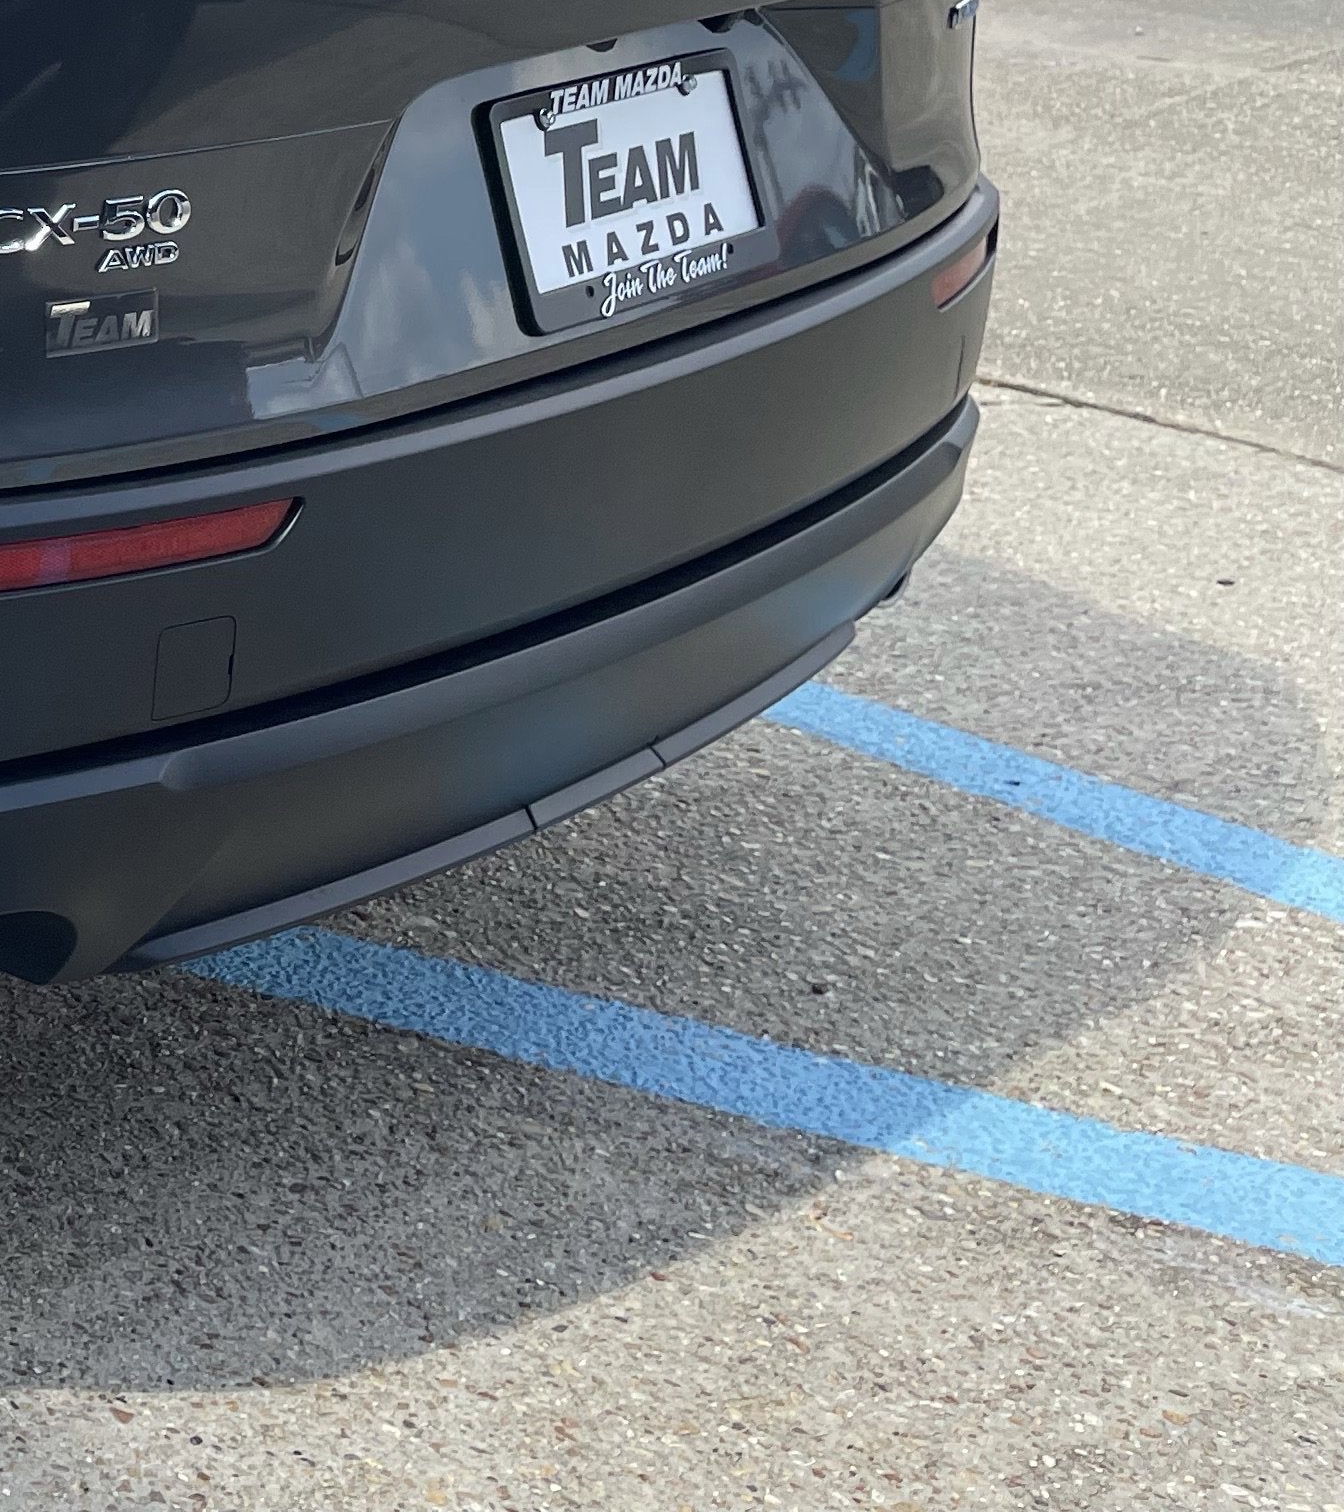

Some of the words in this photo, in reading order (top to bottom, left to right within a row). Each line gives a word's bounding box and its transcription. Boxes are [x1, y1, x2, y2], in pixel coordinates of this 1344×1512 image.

[550, 82, 610, 116] TEAM
[614, 61, 682, 101] MAZDA
[543, 118, 700, 228] TEAM
[97, 240, 179, 273] AWD
[561, 203, 724, 278] MAZDA
[601, 272, 644, 317] Join
[640, 260, 677, 293] The
[674, 242, 728, 283] Team!
[49, 300, 154, 350] TEAM
